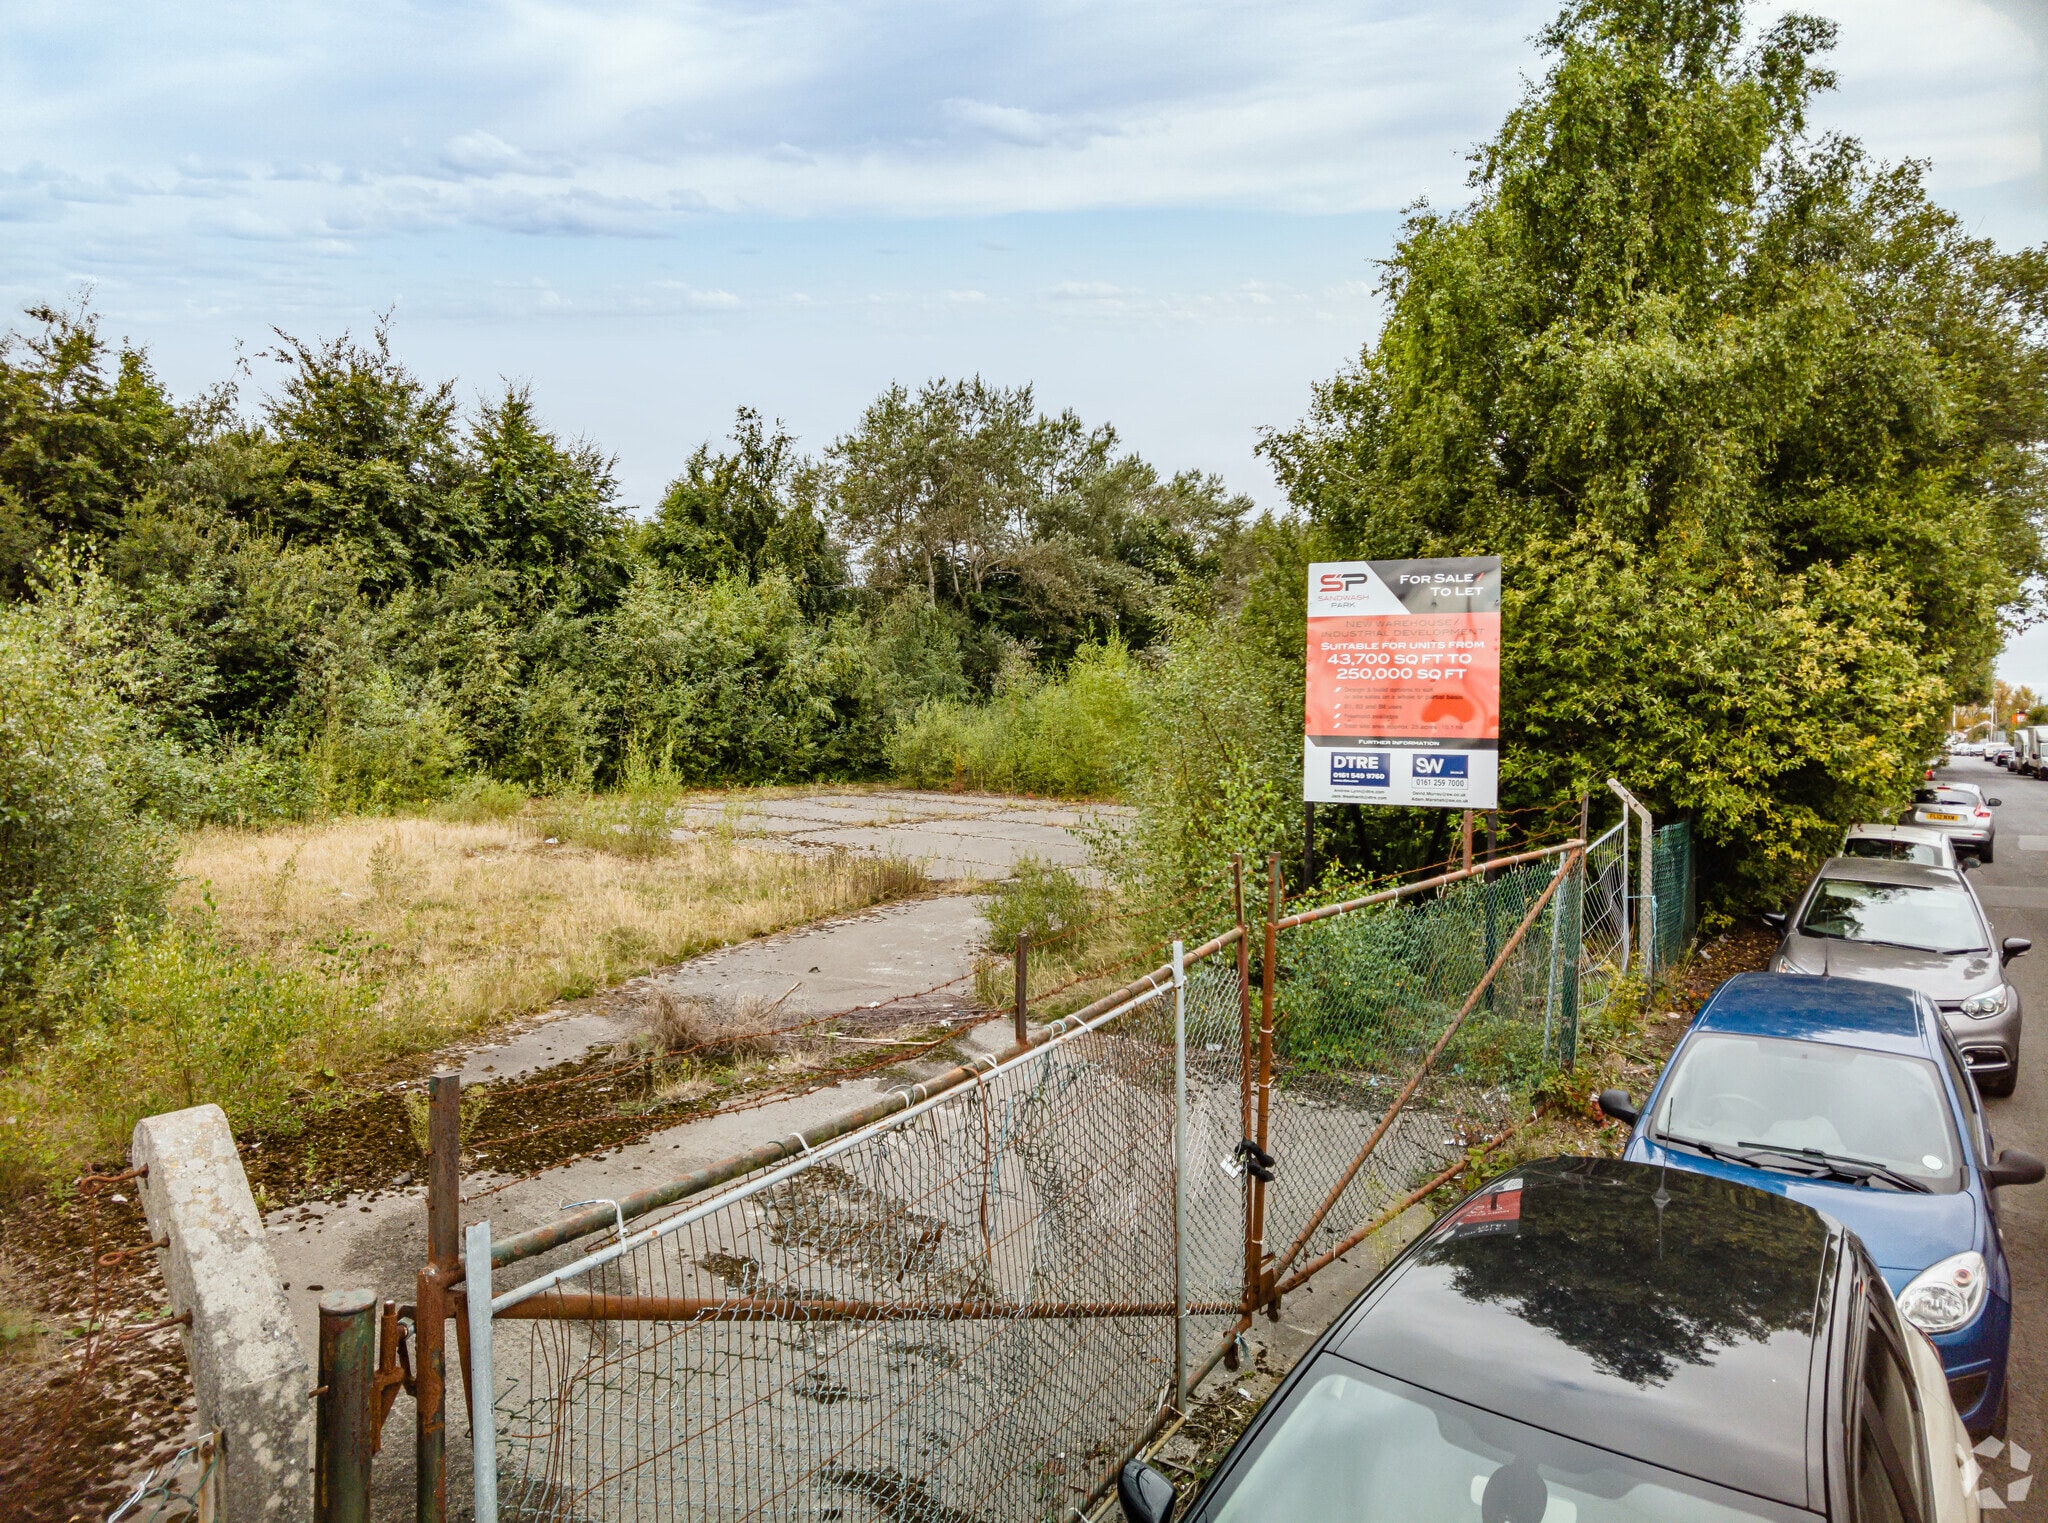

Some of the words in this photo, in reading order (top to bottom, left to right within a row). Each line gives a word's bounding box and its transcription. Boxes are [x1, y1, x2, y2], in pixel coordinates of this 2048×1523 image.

[1399, 574, 1431, 584] FOR
[1434, 573, 1474, 583] SALE
[1430, 587, 1451, 597] TO
[1455, 586, 1484, 596] LET
[1317, 594, 1369, 602] SANDWASH
[1345, 620, 1373, 628] NEW
[1321, 629, 1390, 638] INDUSTRIAL
[1394, 628, 1485, 637] DEVELOPMENT
[1320, 642, 1379, 651] SUITABLE
[1381, 642, 1407, 650] FOR
[1409, 641, 1445, 650] UNITS
[1448, 641, 1485, 649] FROM
[1327, 653, 1391, 667] 43,700
[1393, 654, 1419, 665] SQ
[1421, 654, 1443, 664] FT
[1446, 653, 1473, 664] TO
[1336, 668, 1413, 681] 250,000
[1416, 669, 1442, 680] SQ
[1445, 668, 1468, 679] FT
[1333, 755, 1379, 770] DTRE
[1415, 757, 1445, 774] SW
[1434, 779, 1446, 787] 259
[1448, 780, 1465, 788] 7000
